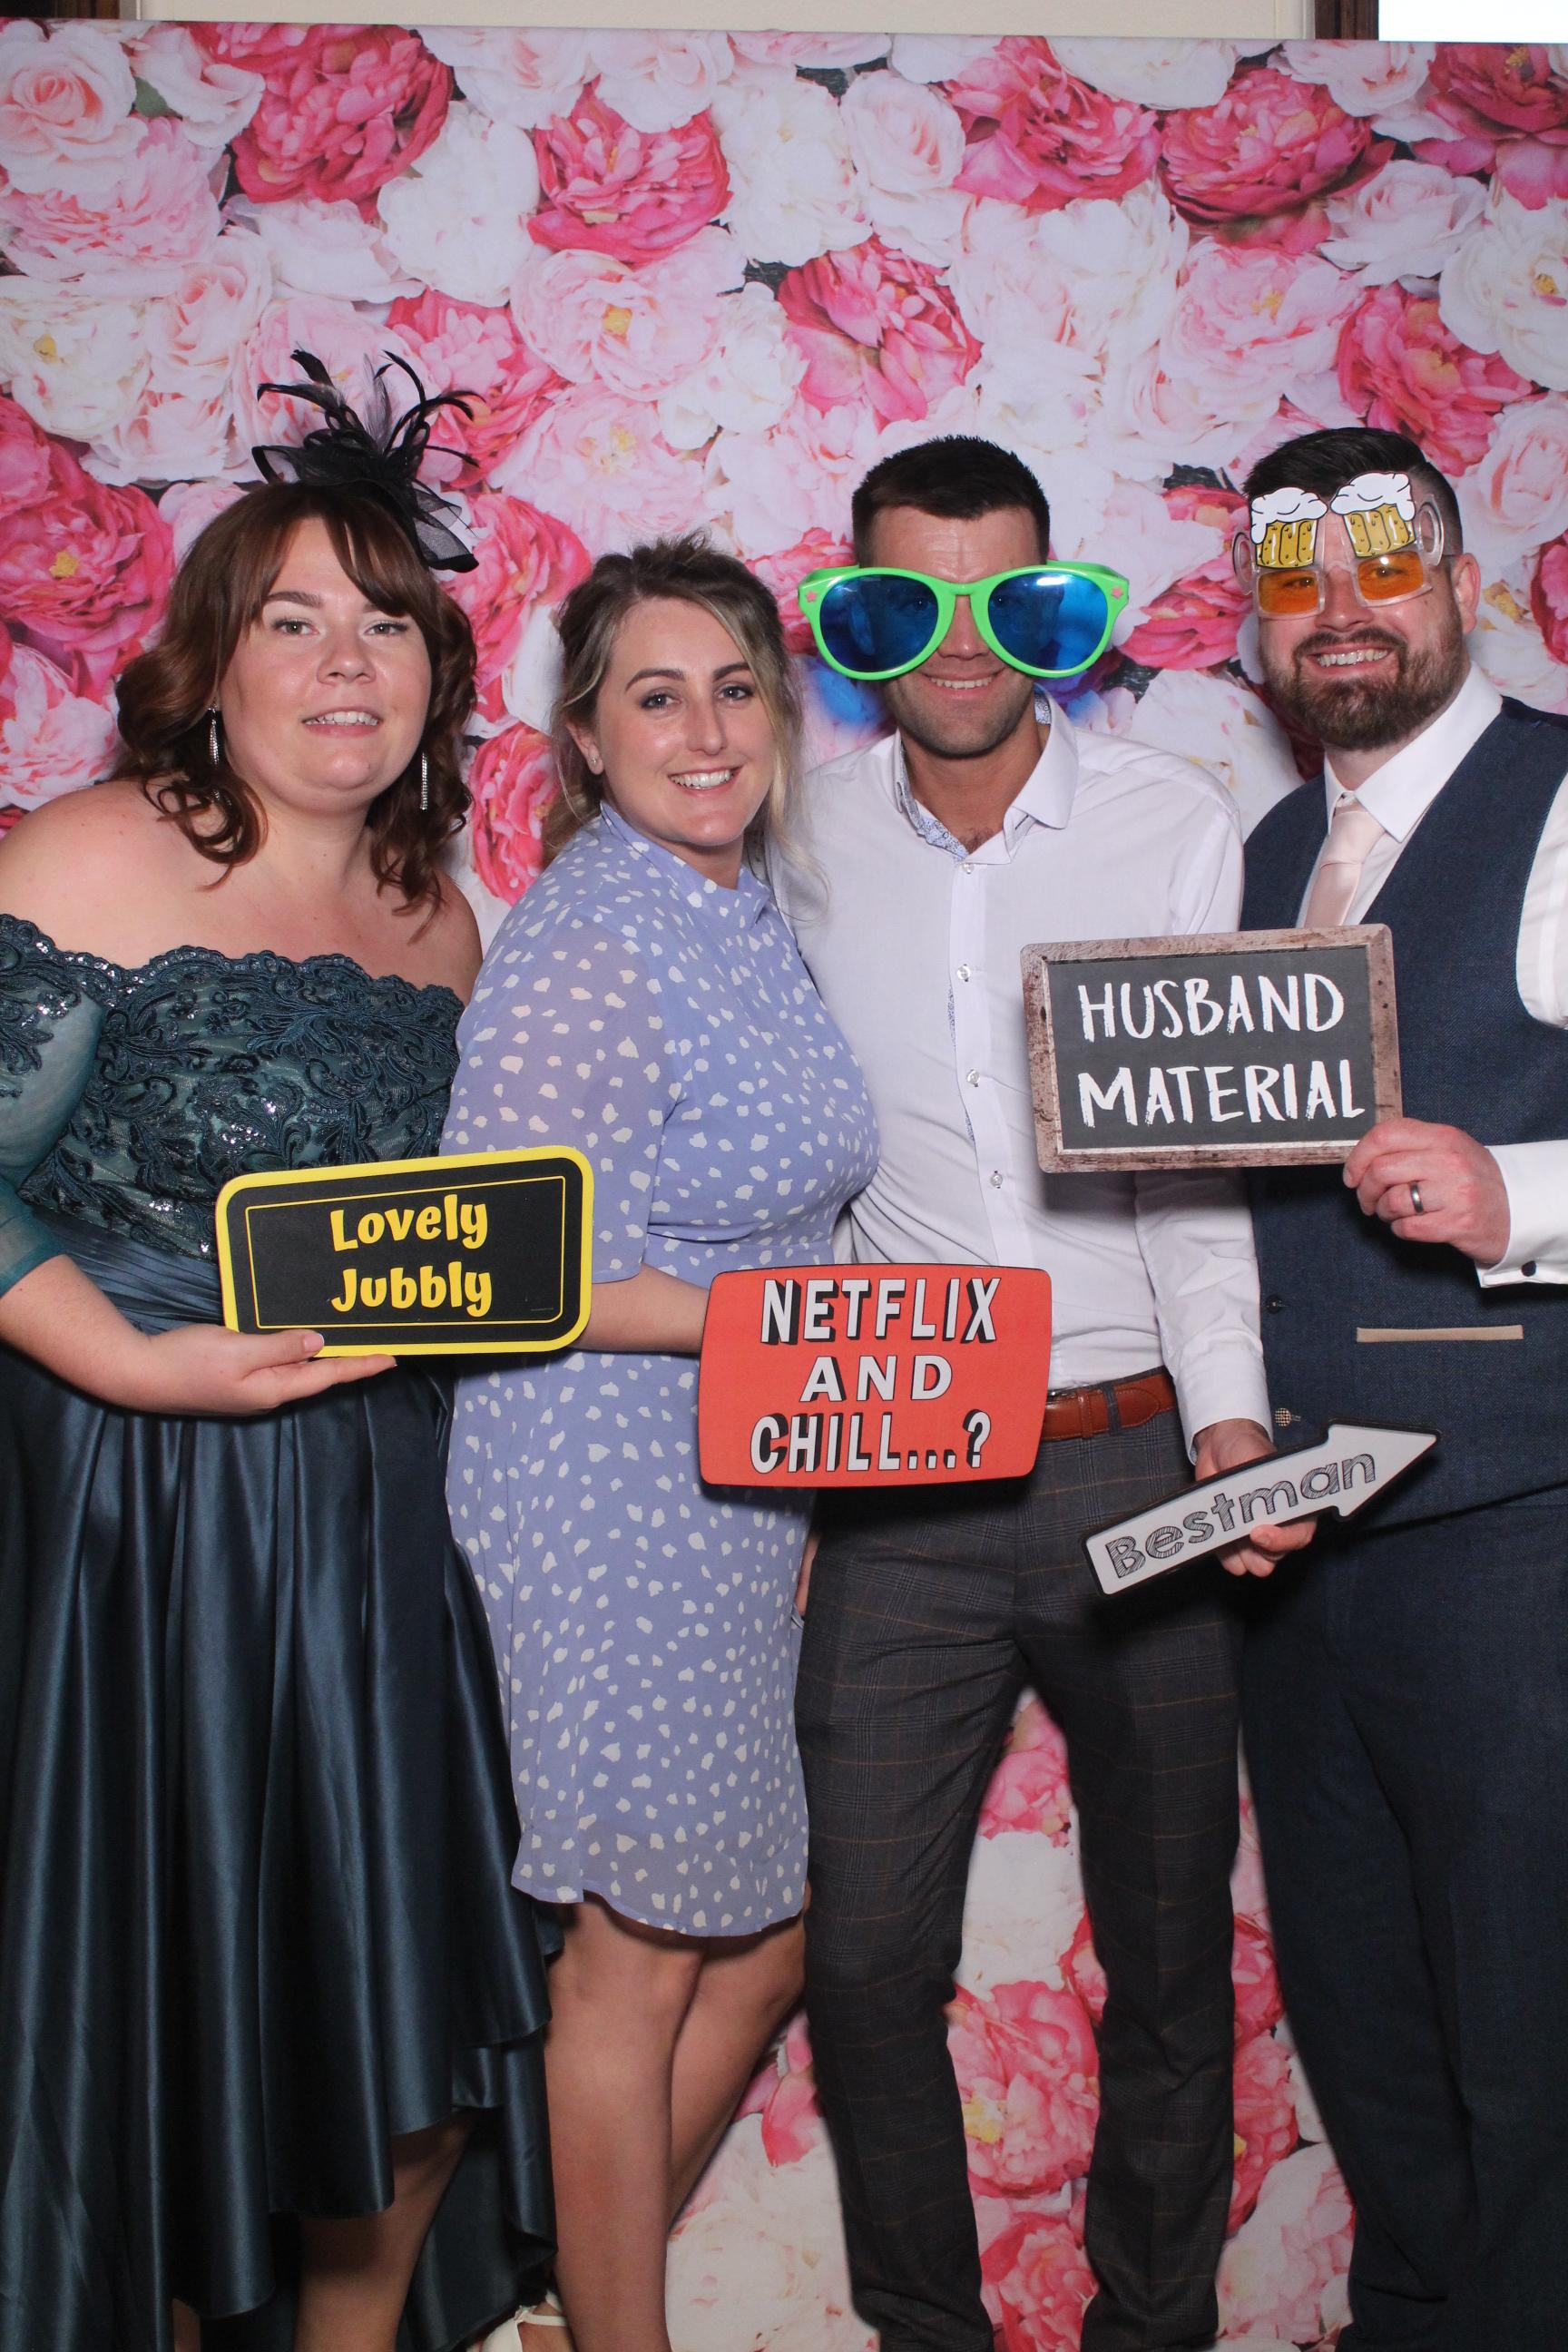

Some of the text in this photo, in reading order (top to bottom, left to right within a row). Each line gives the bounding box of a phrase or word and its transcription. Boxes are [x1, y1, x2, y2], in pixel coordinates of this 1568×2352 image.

[1078, 973, 1345, 1043] HUSBAND
[1077, 1059, 1366, 1128] MATERIAL
[329, 1193, 489, 1252] Lovely
[330, 1259, 493, 1318] Jubbly
[760, 1277, 1002, 1346] NETFLIX
[799, 1354, 953, 1403] AND
[1104, 1452, 1377, 1579] Bestman
